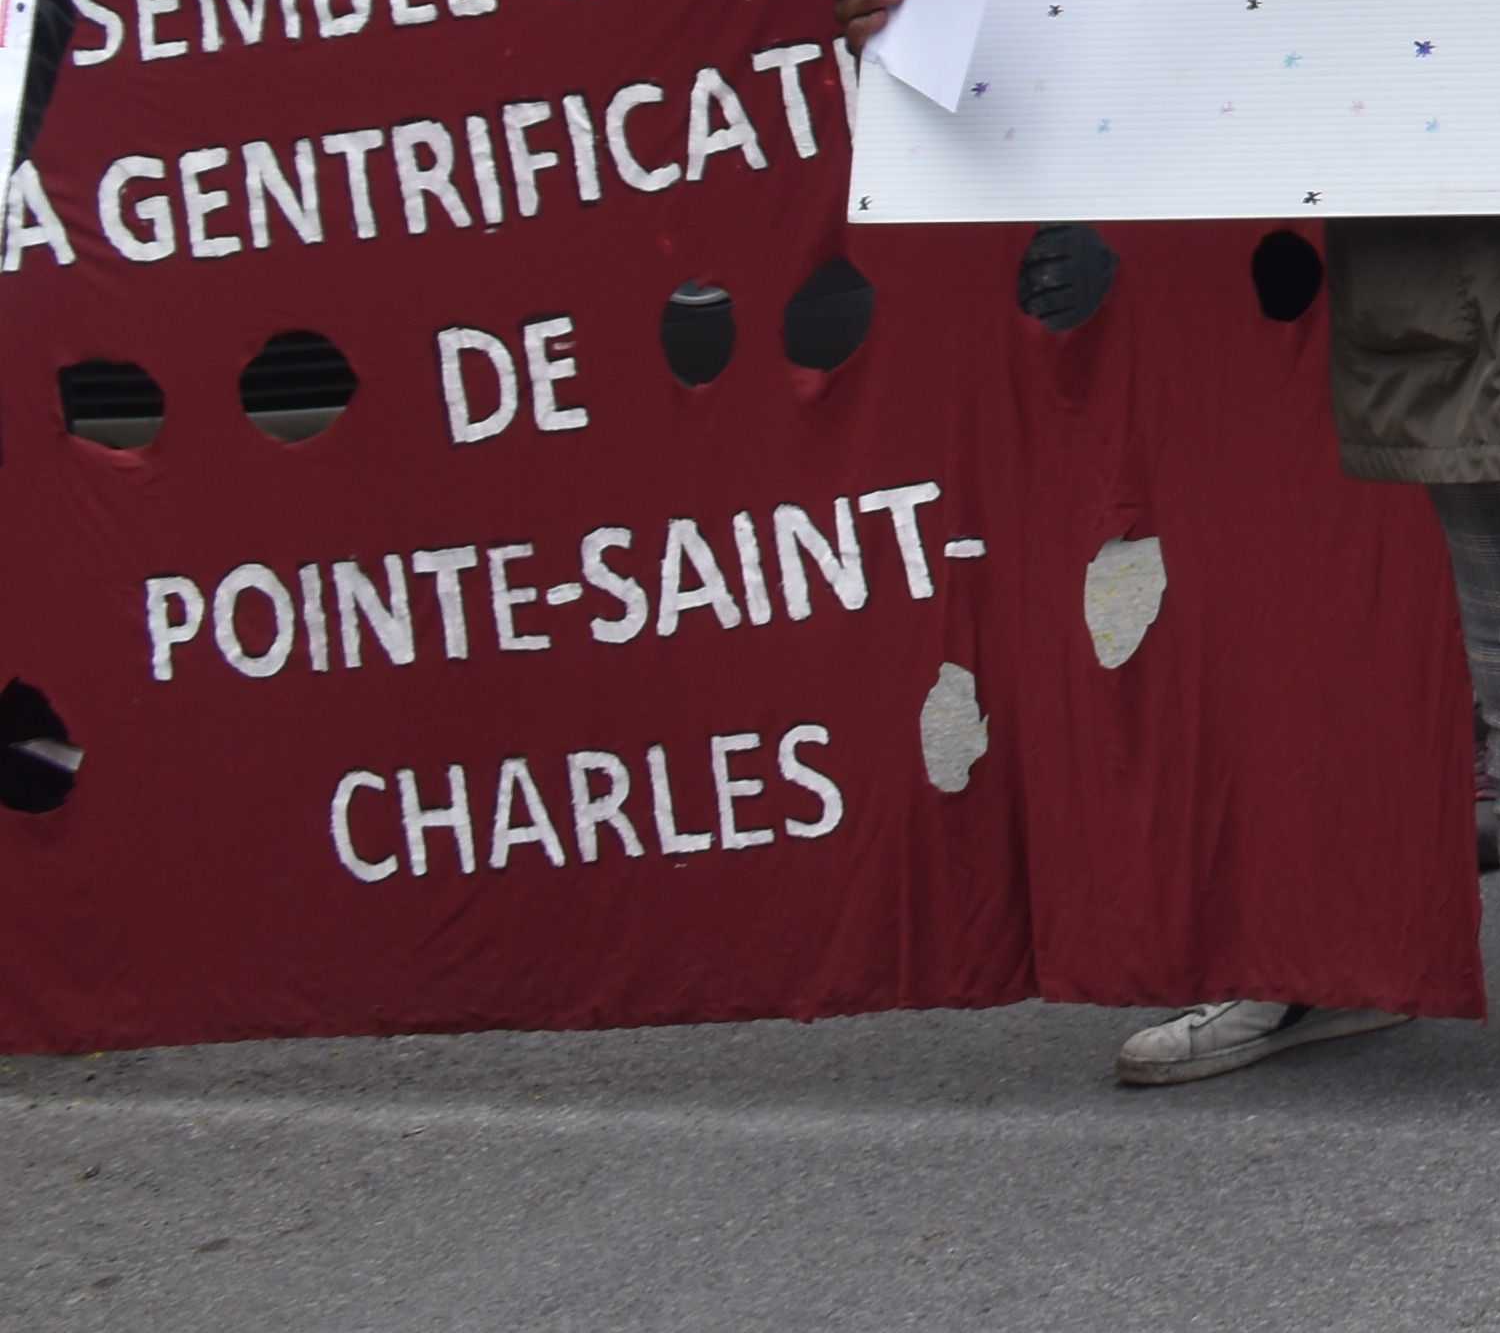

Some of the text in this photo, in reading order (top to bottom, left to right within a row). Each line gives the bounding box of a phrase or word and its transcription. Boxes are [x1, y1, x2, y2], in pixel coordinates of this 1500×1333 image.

[437, 315, 589, 445] DE
[143, 481, 988, 682] POINTE-SAINT-
[329, 724, 845, 883] CHARLES
